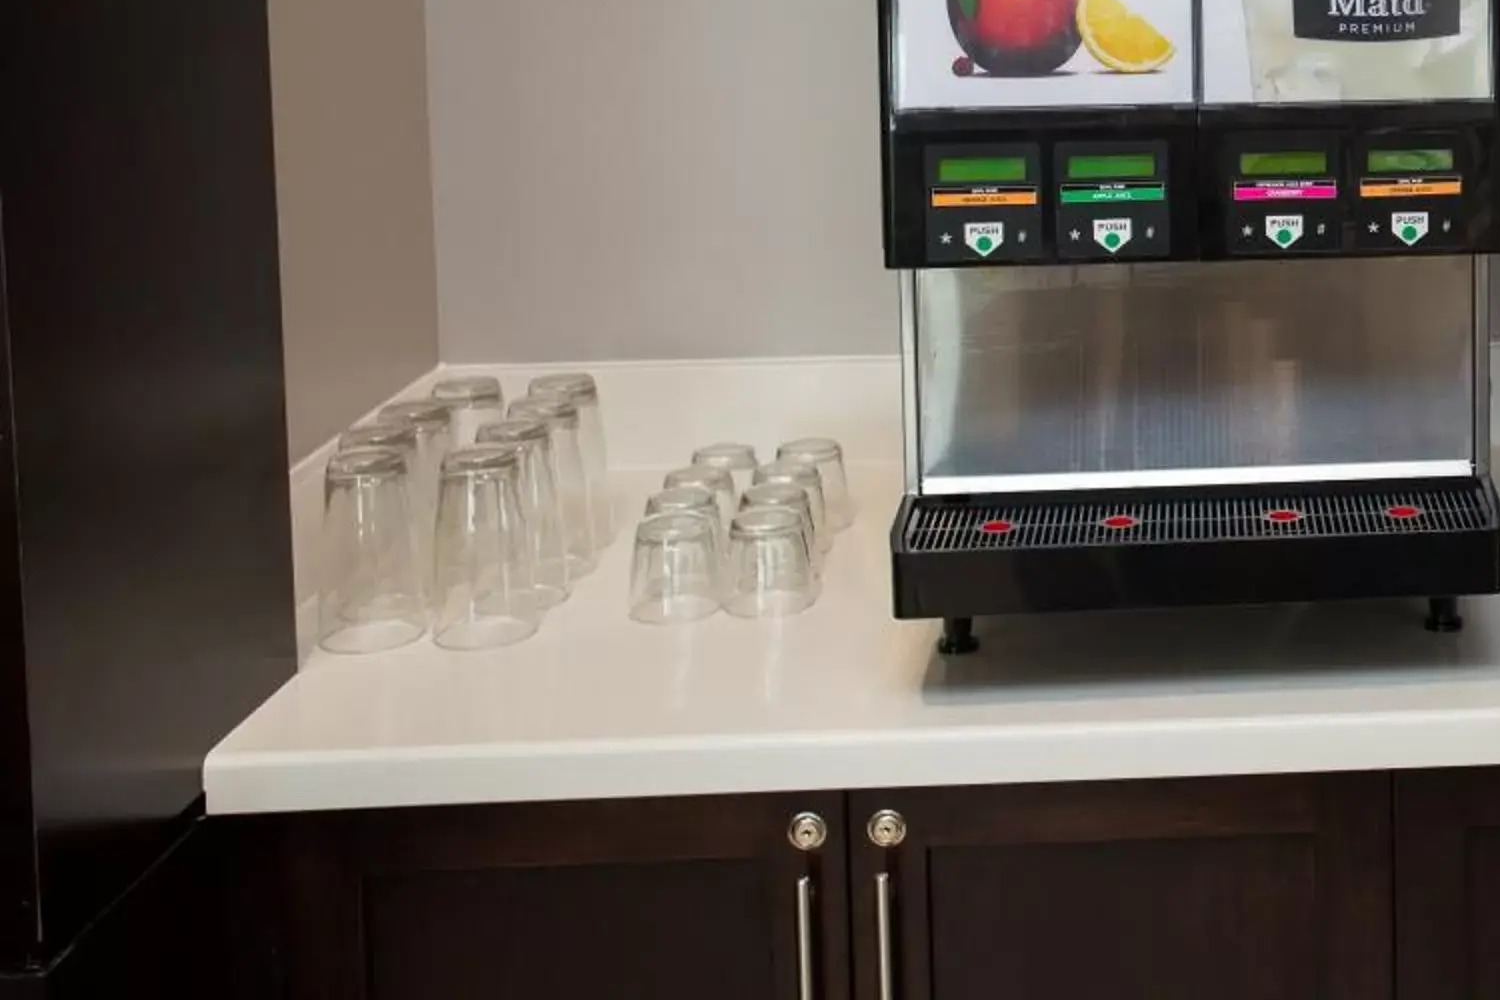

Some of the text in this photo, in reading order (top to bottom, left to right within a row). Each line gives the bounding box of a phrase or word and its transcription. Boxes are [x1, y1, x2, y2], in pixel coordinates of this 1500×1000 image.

[1339, 22, 1416, 34] PREMIUM
[1270, 219, 1299, 228] PUSH
[1396, 215, 1425, 225] PUSH
[969, 226, 999, 235] PUSH
[1097, 223, 1127, 231] PUSH
